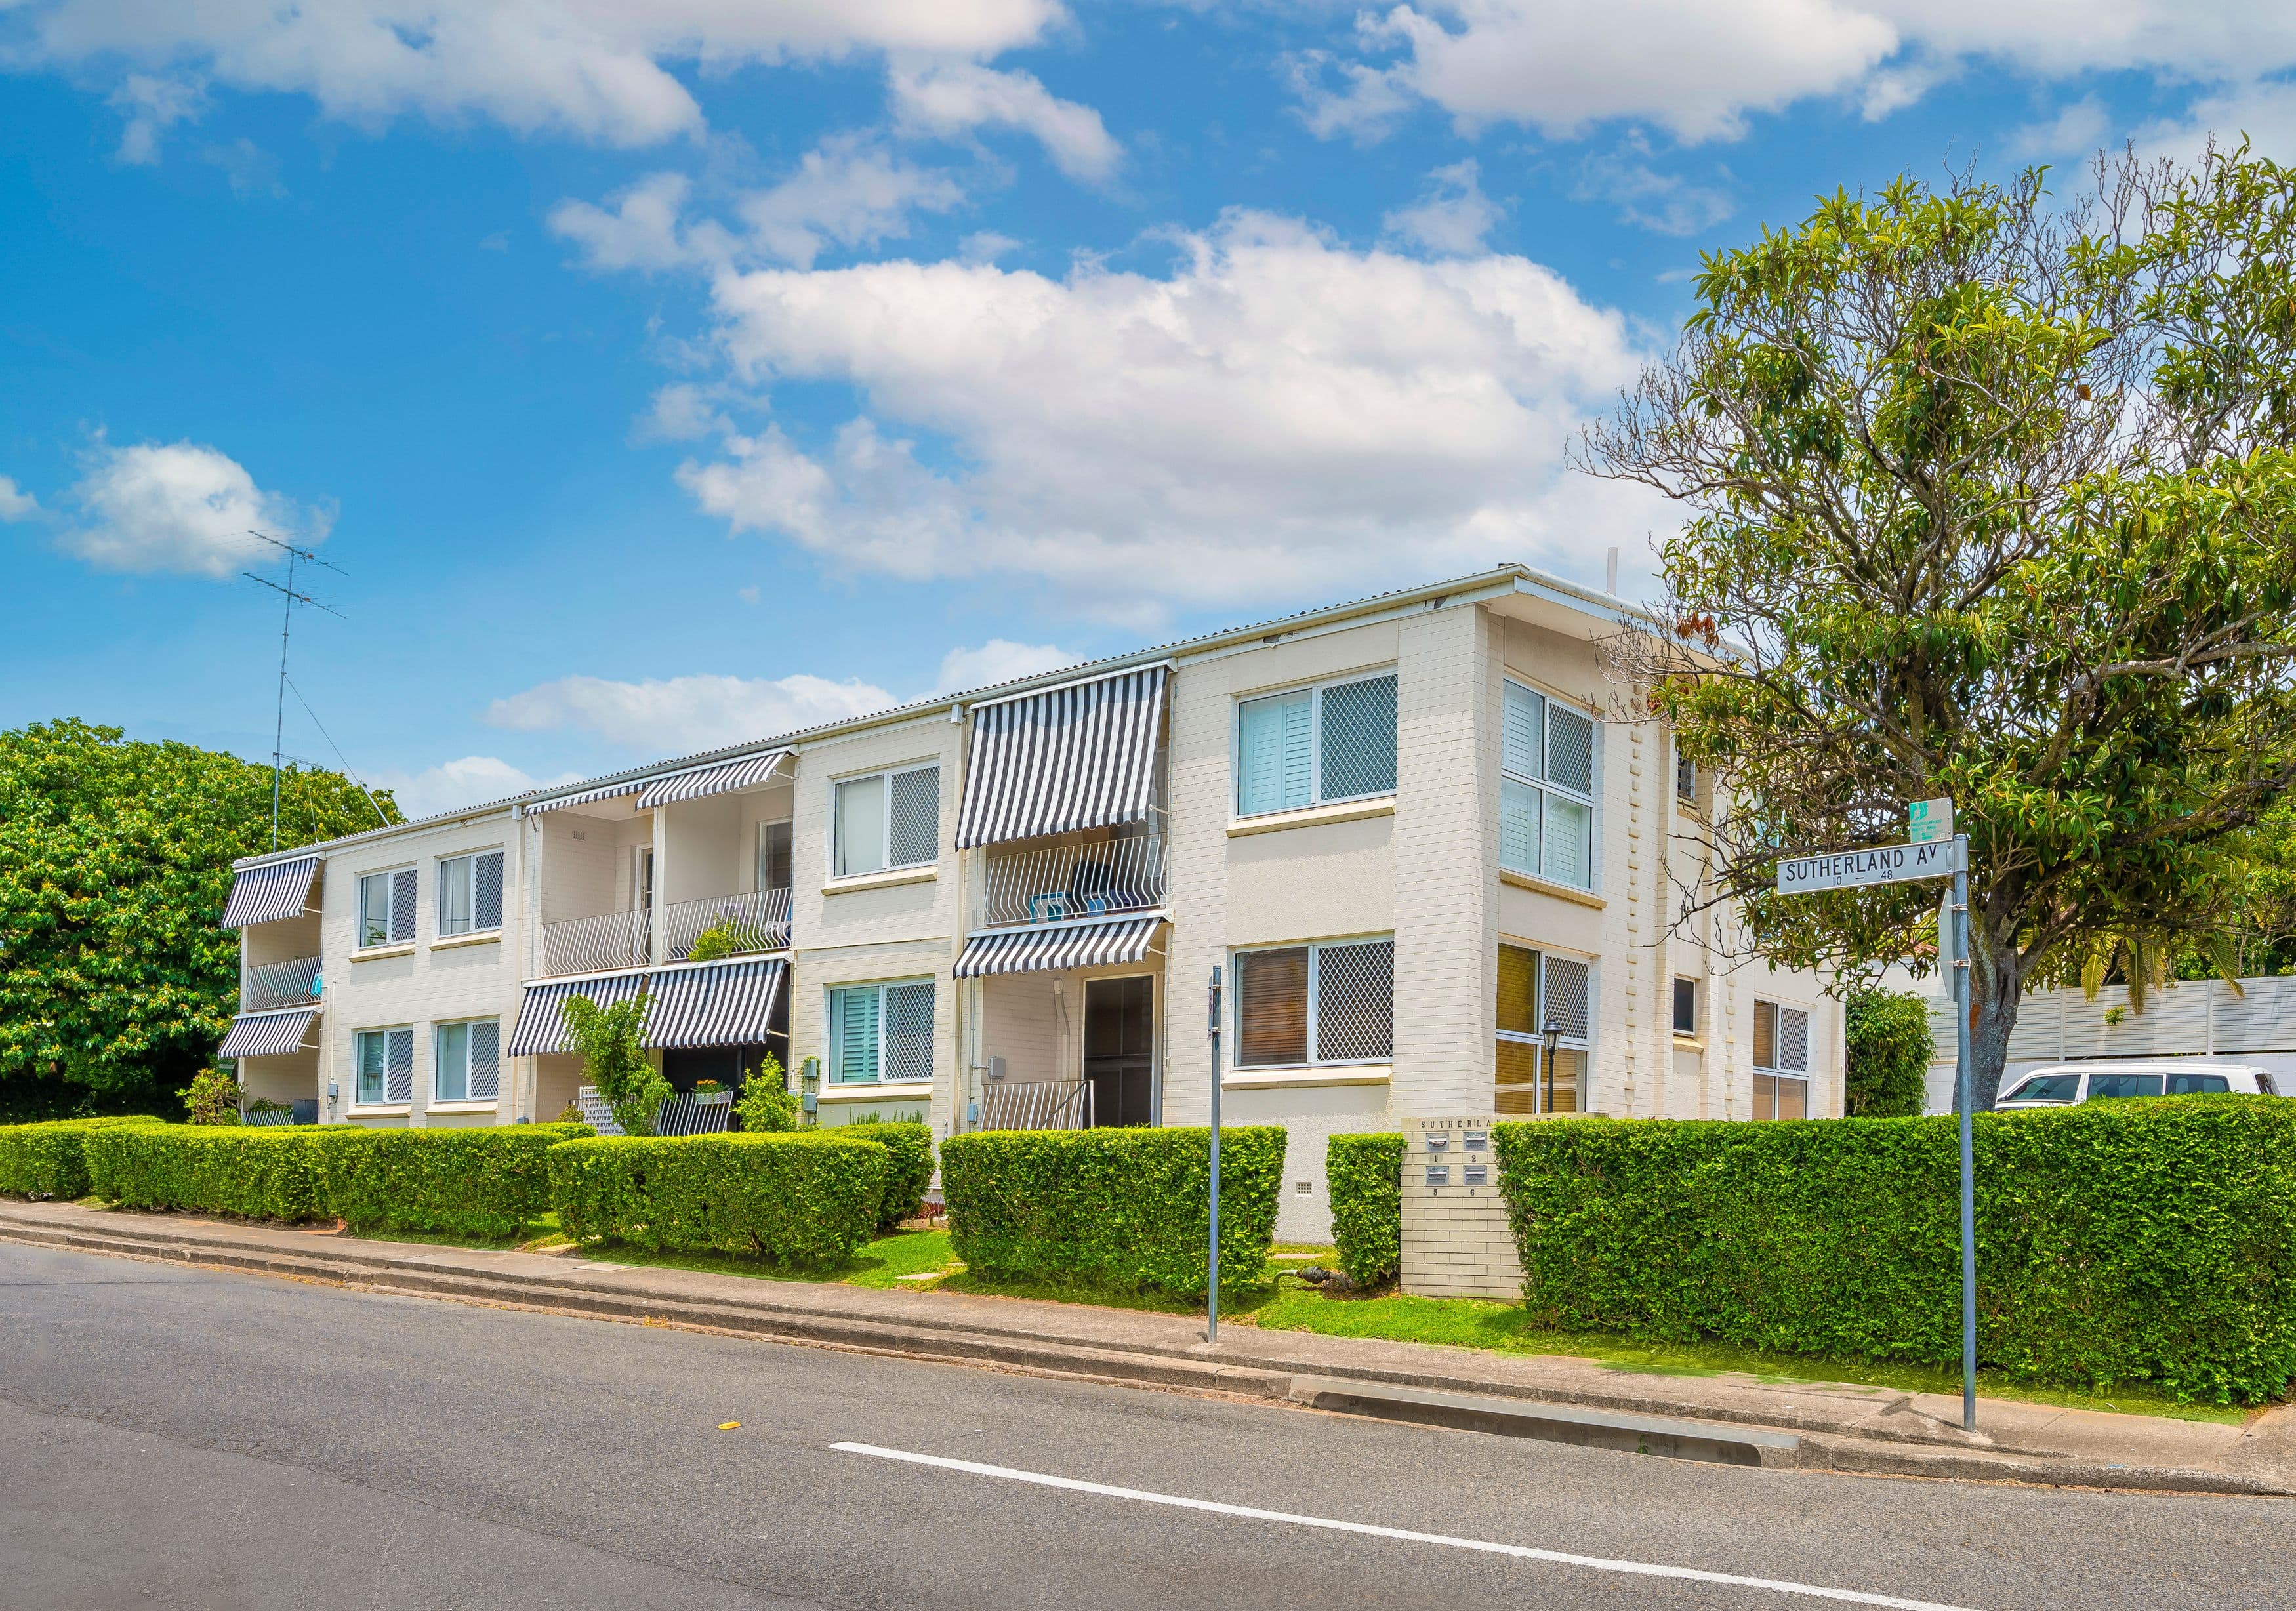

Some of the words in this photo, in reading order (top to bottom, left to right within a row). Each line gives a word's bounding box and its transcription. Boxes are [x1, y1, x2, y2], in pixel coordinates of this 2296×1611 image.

[1786, 849, 1904, 882] SUTHERLAND
[1917, 844, 1937, 865] AV
[1832, 876, 1842, 886] 10
[1880, 870, 1893, 880] 48
